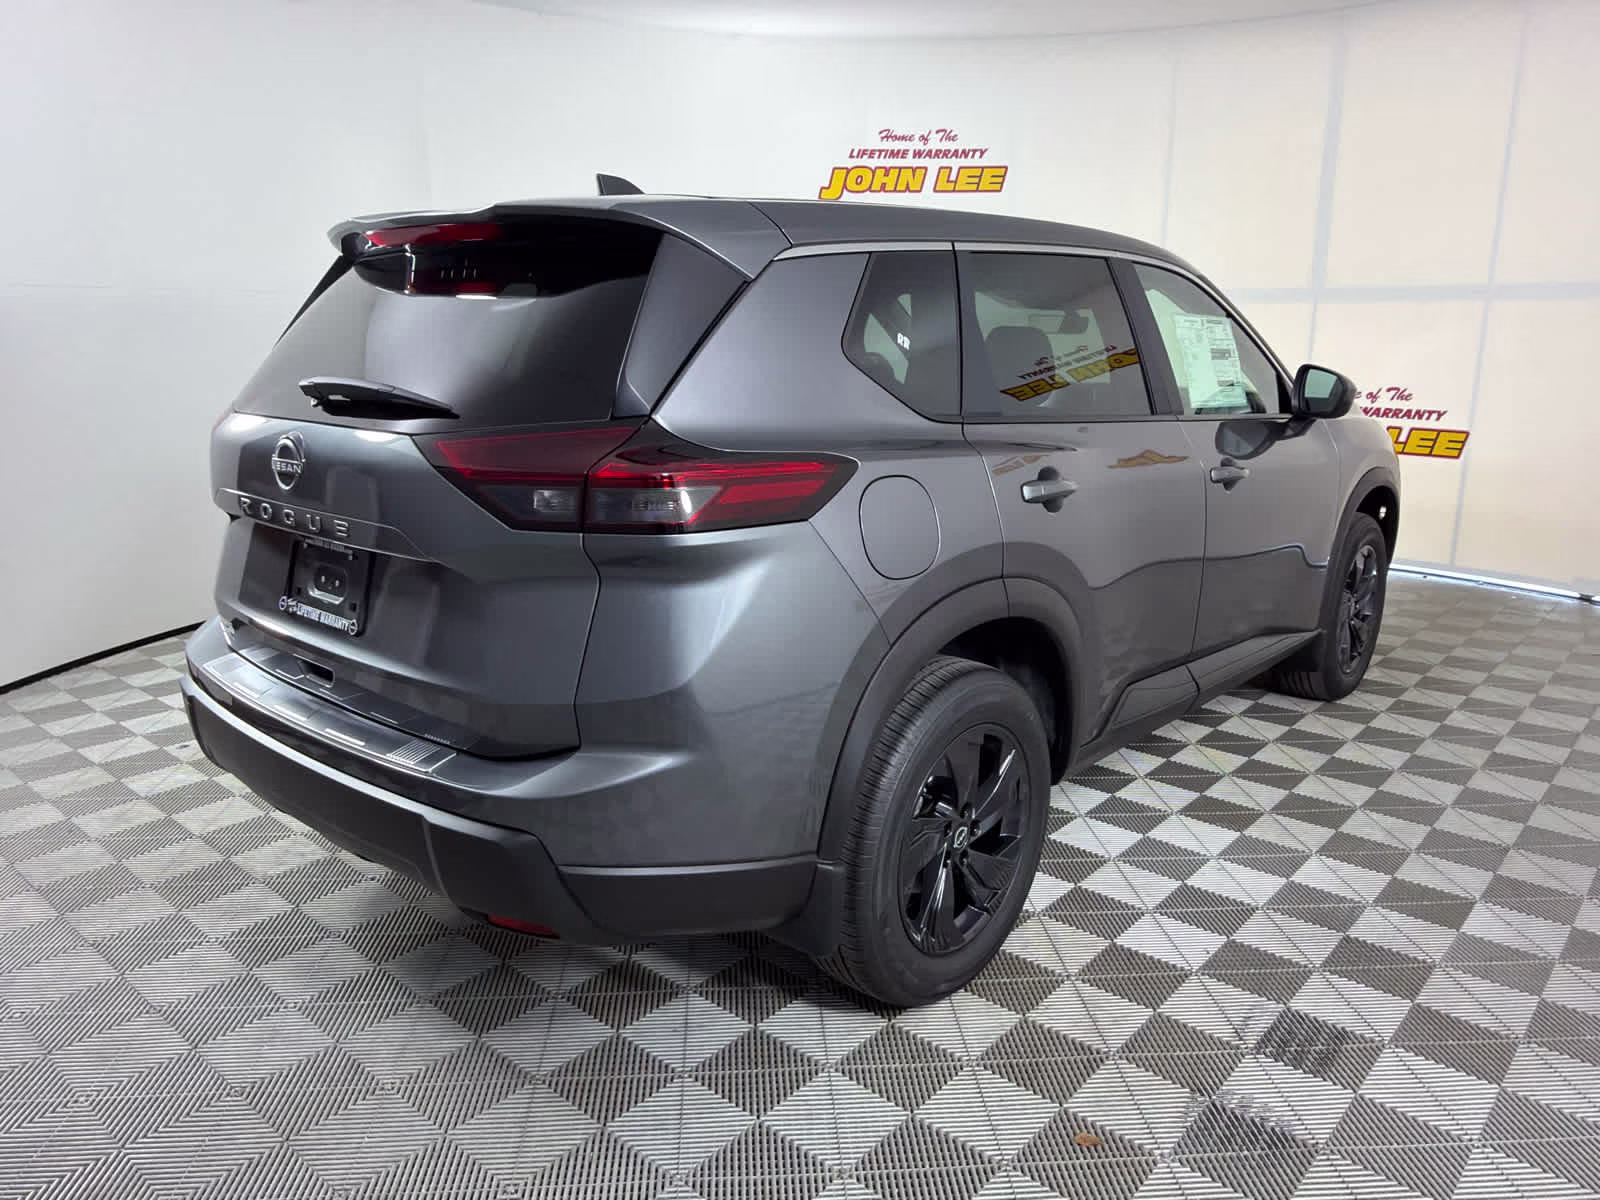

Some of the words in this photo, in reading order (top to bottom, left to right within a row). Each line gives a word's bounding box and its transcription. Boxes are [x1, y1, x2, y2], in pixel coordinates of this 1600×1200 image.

[878, 128, 915, 143] Home
[918, 130, 933, 146] of
[935, 128, 959, 142] The
[848, 148, 909, 160] LIFETIME
[912, 148, 988, 160] WARRANTY
[818, 166, 928, 200] JOHN
[933, 166, 1008, 193] LEE
[1366, 387, 1382, 404] of
[1386, 386, 1413, 401] The
[1360, 406, 1448, 422] WARRANTY
[1386, 425, 1470, 459] LEE
[272, 459, 302, 474] SSAN
[240, 497, 351, 538] ROGUE
